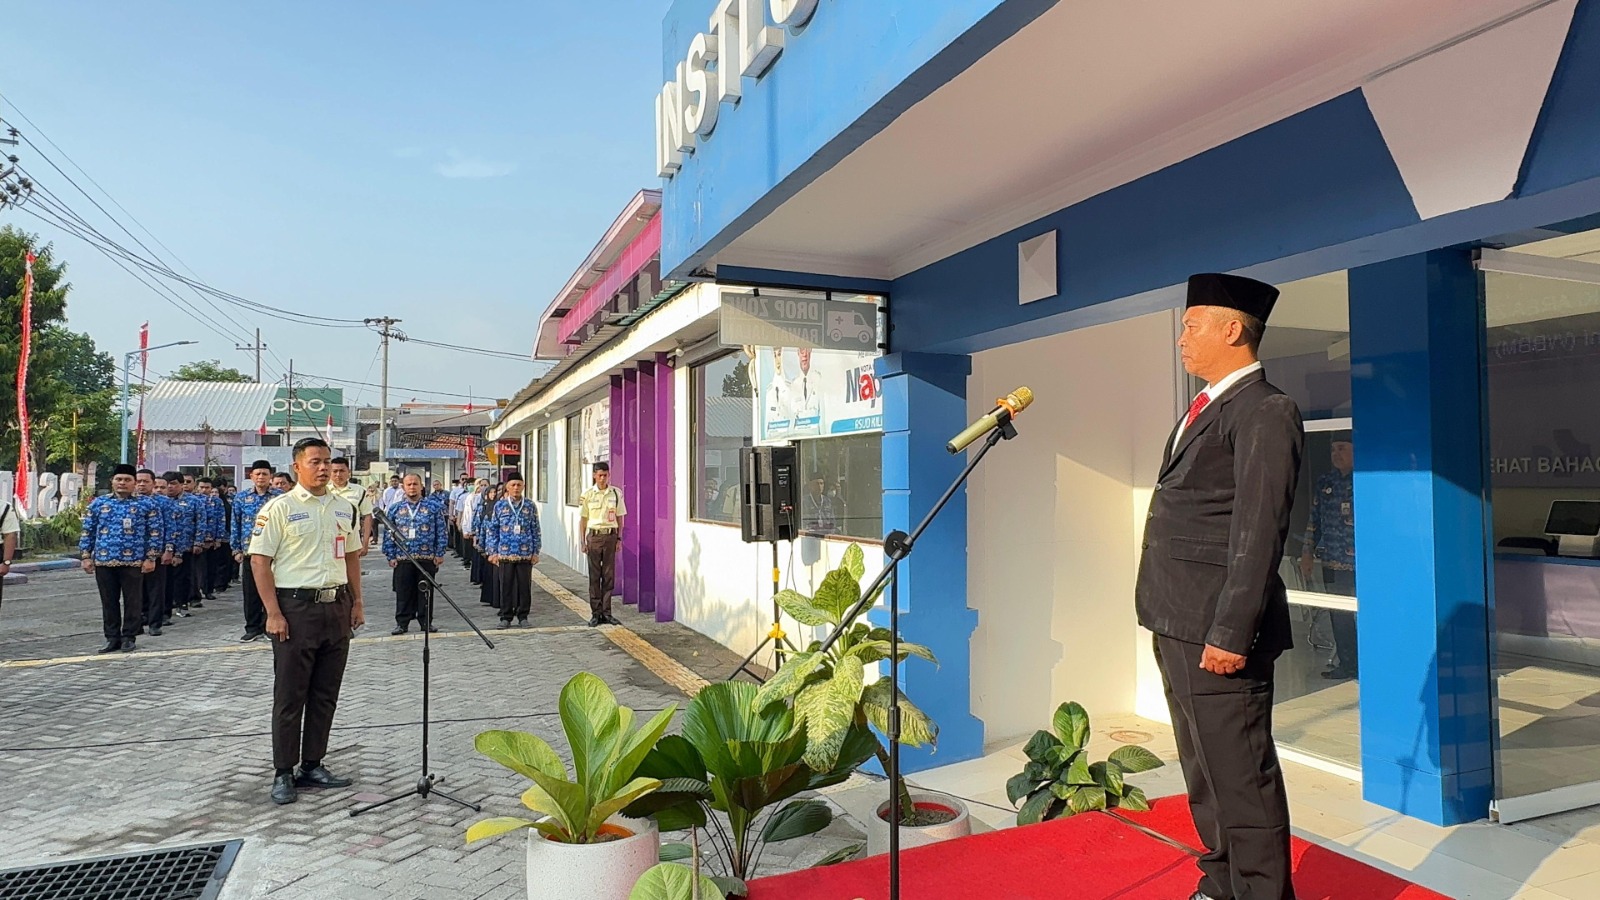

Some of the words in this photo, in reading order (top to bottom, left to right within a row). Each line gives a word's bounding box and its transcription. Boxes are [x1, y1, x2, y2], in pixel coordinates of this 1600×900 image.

[655, 0, 819, 178] INSTL
[854, 417, 871, 430] RSUD
[501, 443, 518, 451] IGD
